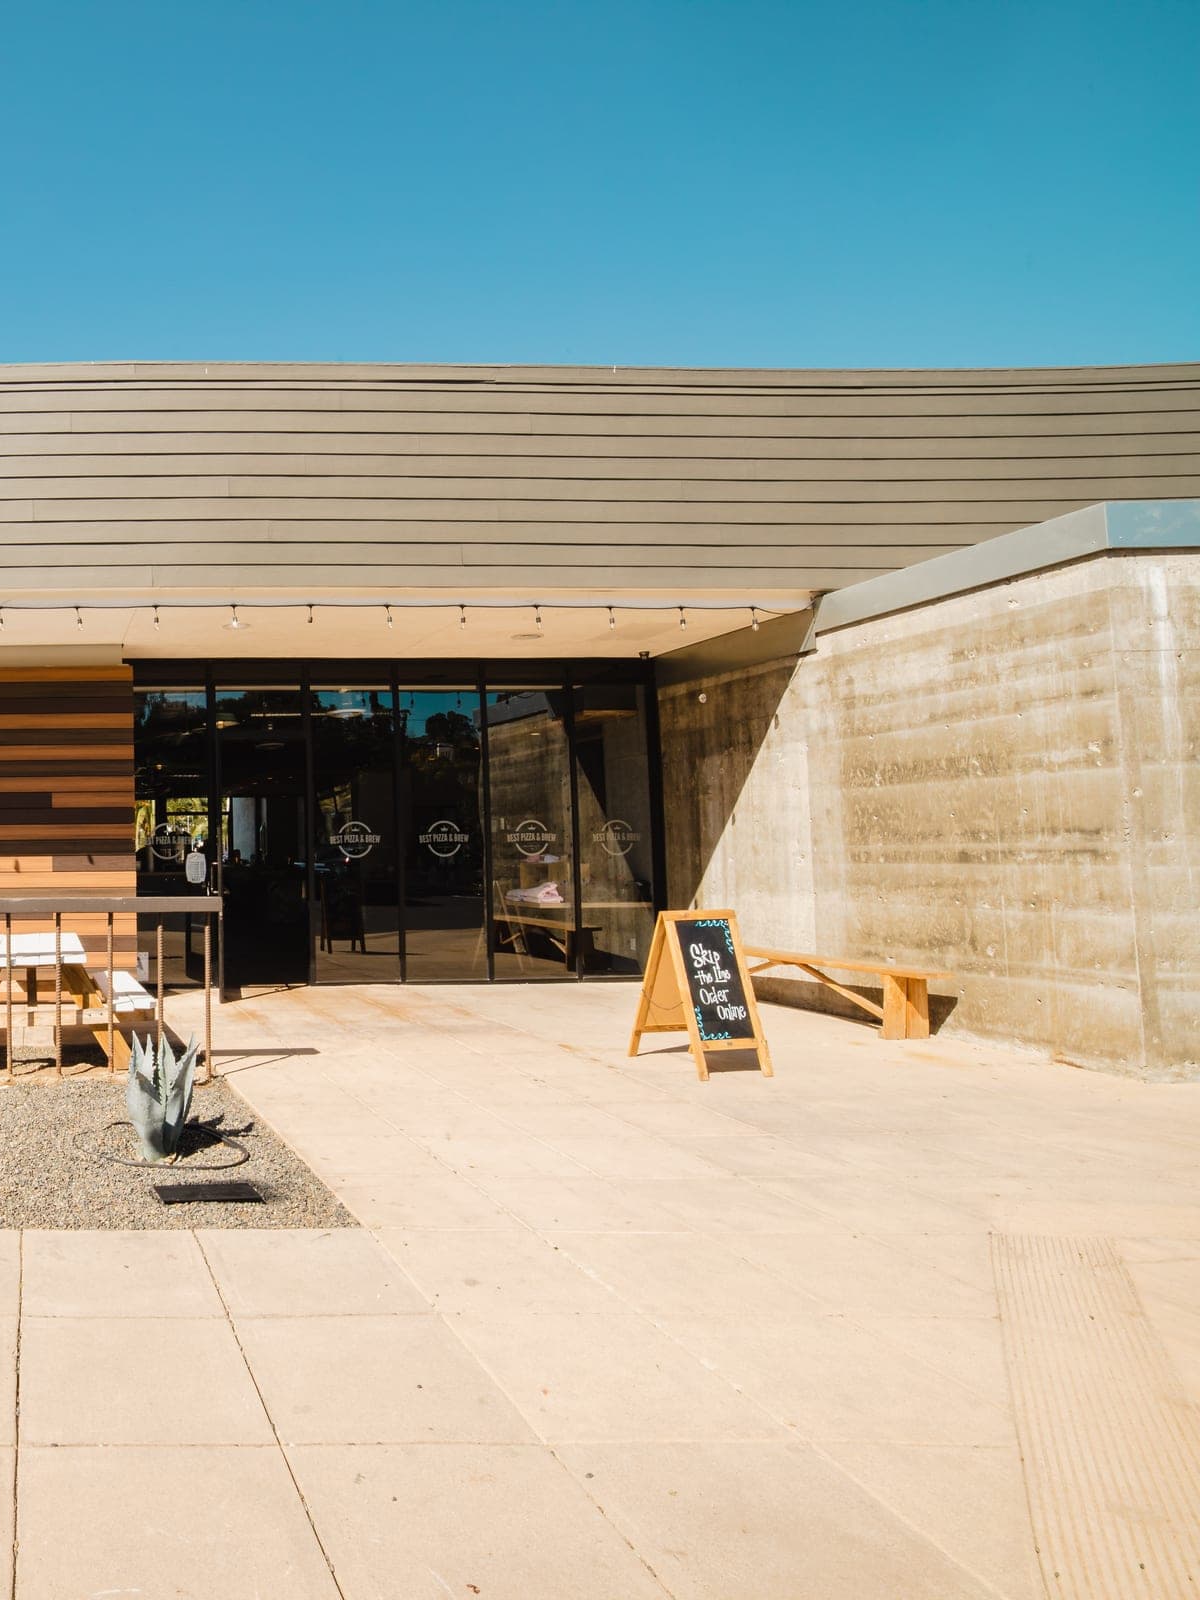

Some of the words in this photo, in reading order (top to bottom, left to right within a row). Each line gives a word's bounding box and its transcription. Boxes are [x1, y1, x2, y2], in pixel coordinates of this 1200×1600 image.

[155, 836, 171, 845] PIZZA
[330, 835, 343, 844] BEST
[344, 835, 359, 843] PIZZA
[360, 835, 365, 843] &
[365, 835, 381, 843] BREW
[419, 834, 432, 843] BEST
[433, 834, 448, 842] PIZZA
[449, 834, 453, 842] &
[454, 834, 469, 842] BREW
[507, 833, 520, 842] BEST
[521, 833, 535, 841] PIZZA
[536, 833, 540, 841] &
[541, 833, 556, 841] BREW
[593, 833, 605, 841] BEST
[606, 833, 621, 841] PIZZA
[626, 833, 640, 841] BREW
[690, 943, 720, 969] Skip
[694, 970, 713, 985] the
[712, 966, 731, 982] Line
[700, 986, 729, 1005] Order
[717, 1003, 746, 1020] Online
